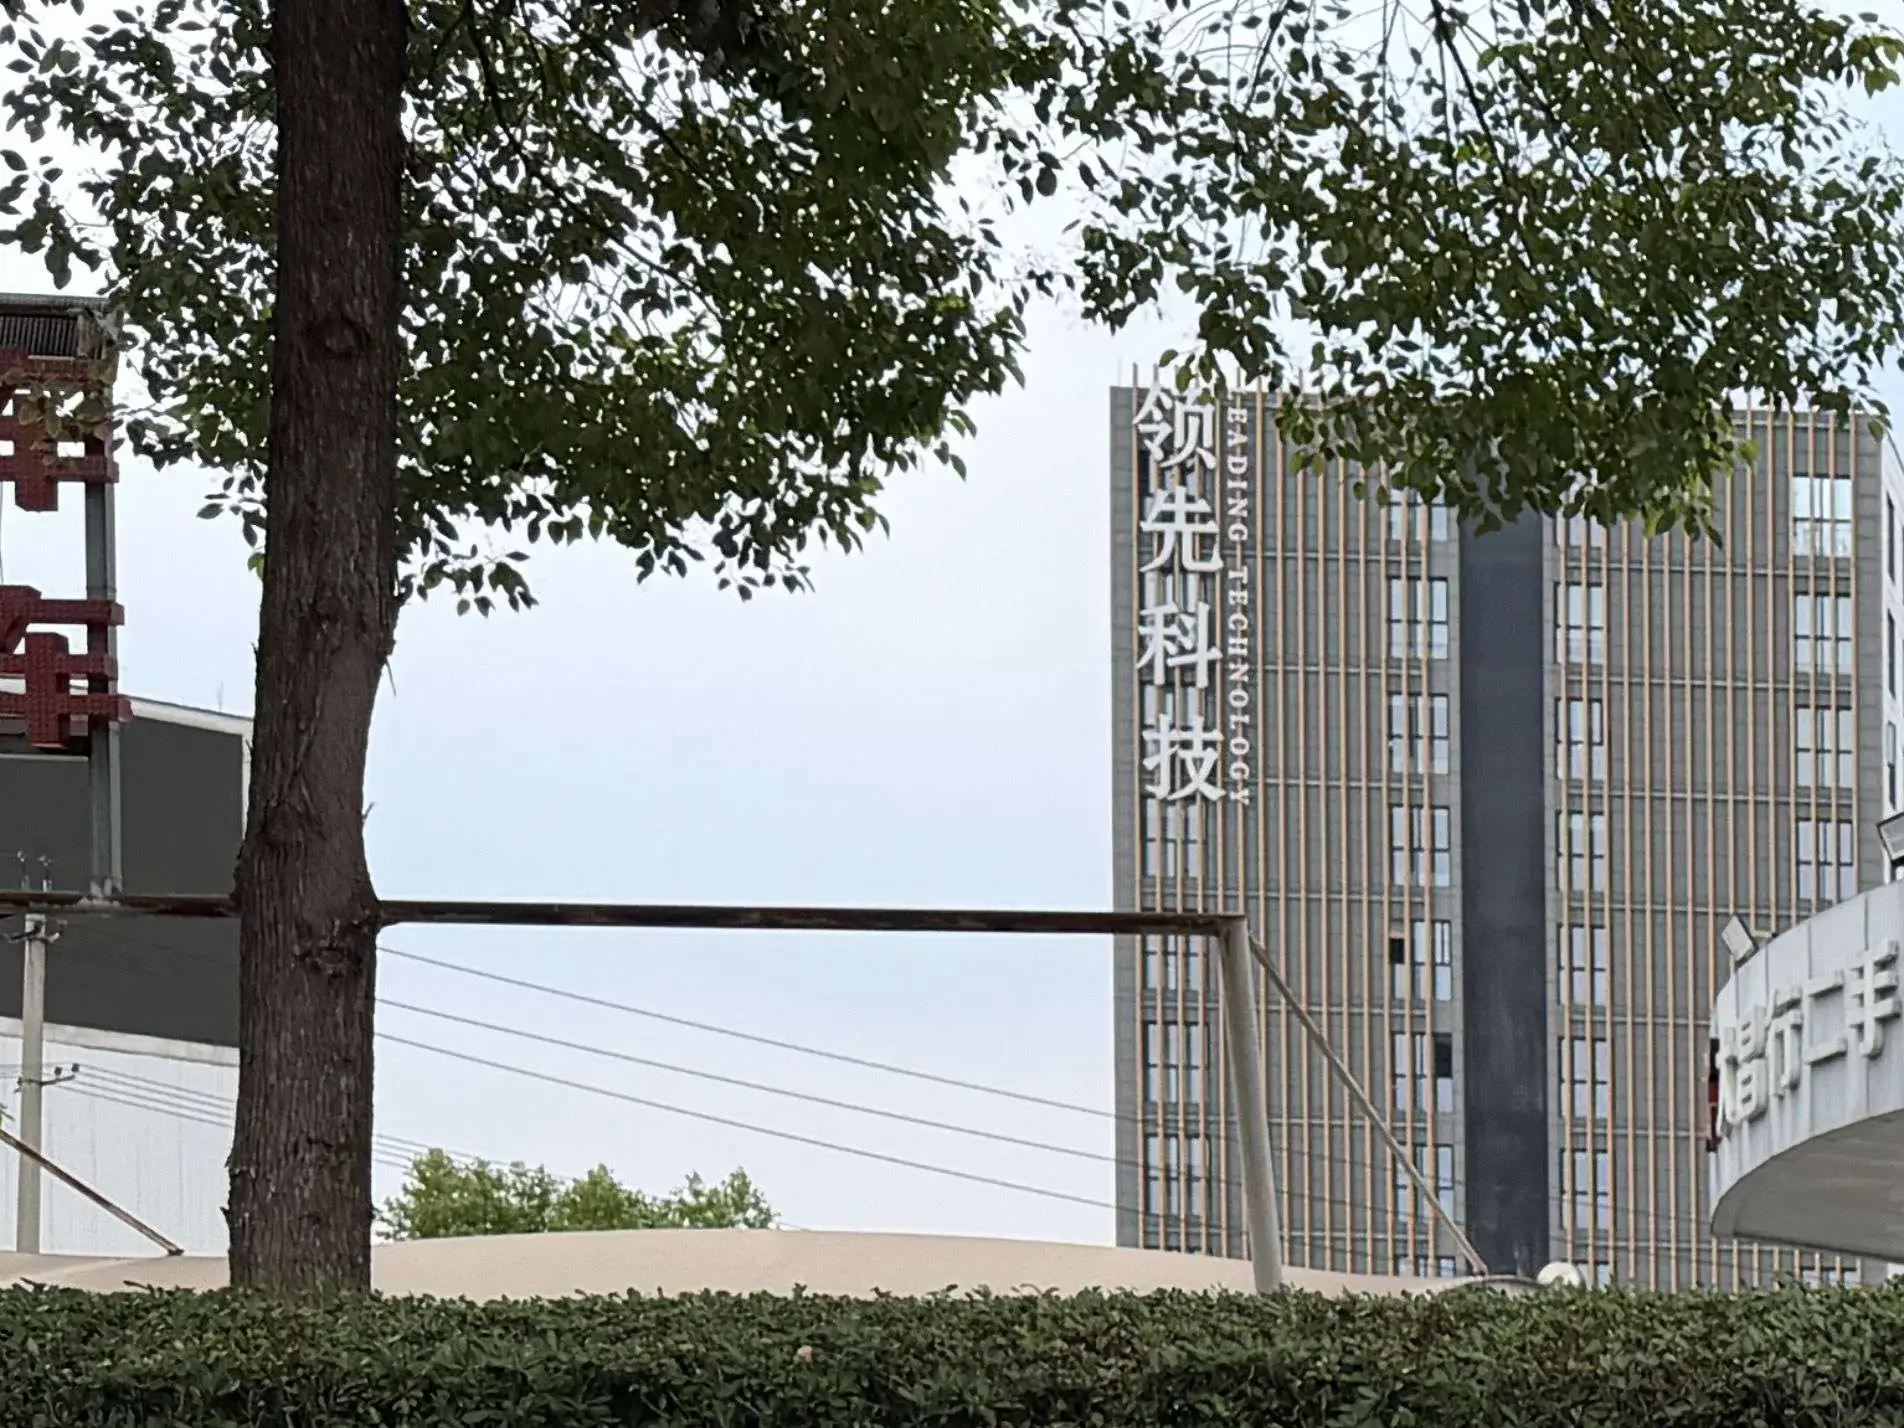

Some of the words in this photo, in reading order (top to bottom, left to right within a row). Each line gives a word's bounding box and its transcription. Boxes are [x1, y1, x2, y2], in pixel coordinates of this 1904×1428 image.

[1132, 380, 1226, 801] 领先科技
[1227, 565, 1250, 806] TECHNOLOGY
